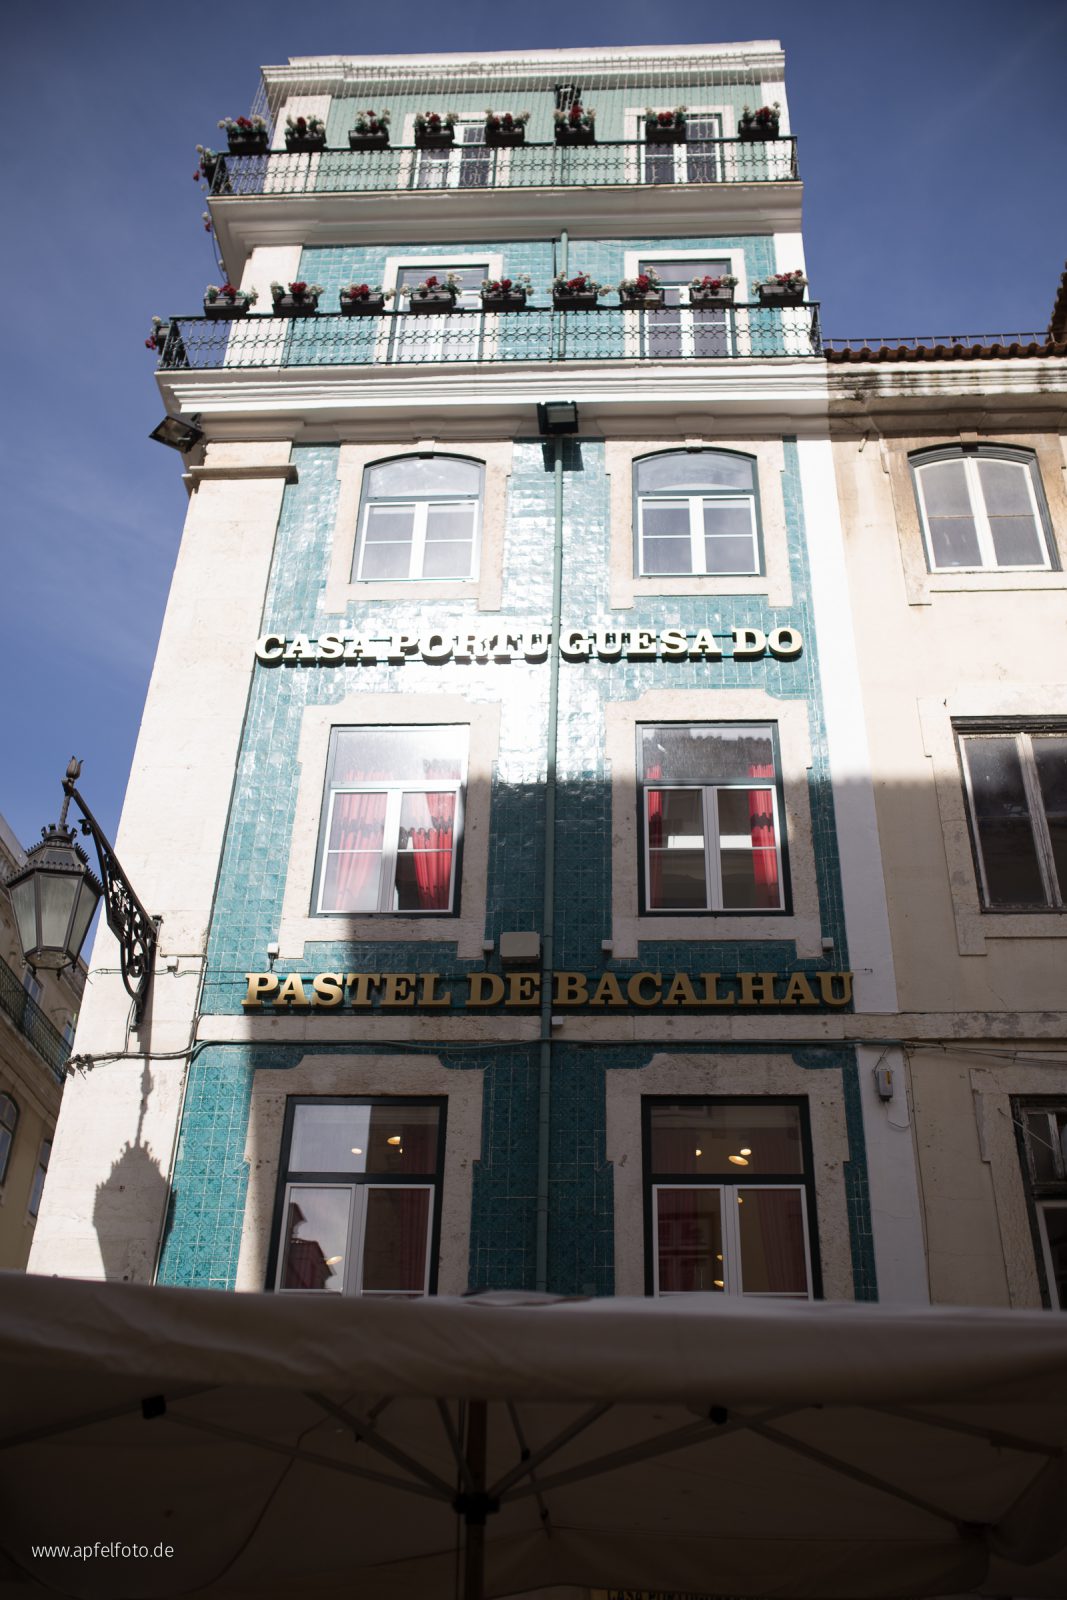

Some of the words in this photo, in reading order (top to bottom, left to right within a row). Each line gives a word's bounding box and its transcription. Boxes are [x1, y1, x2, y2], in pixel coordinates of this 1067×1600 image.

[255, 633, 377, 664] CASA
[731, 627, 803, 659] DO
[241, 972, 452, 1007] PASTEL
[465, 972, 542, 1007] DE
[553, 971, 854, 1006] BACALHAU
